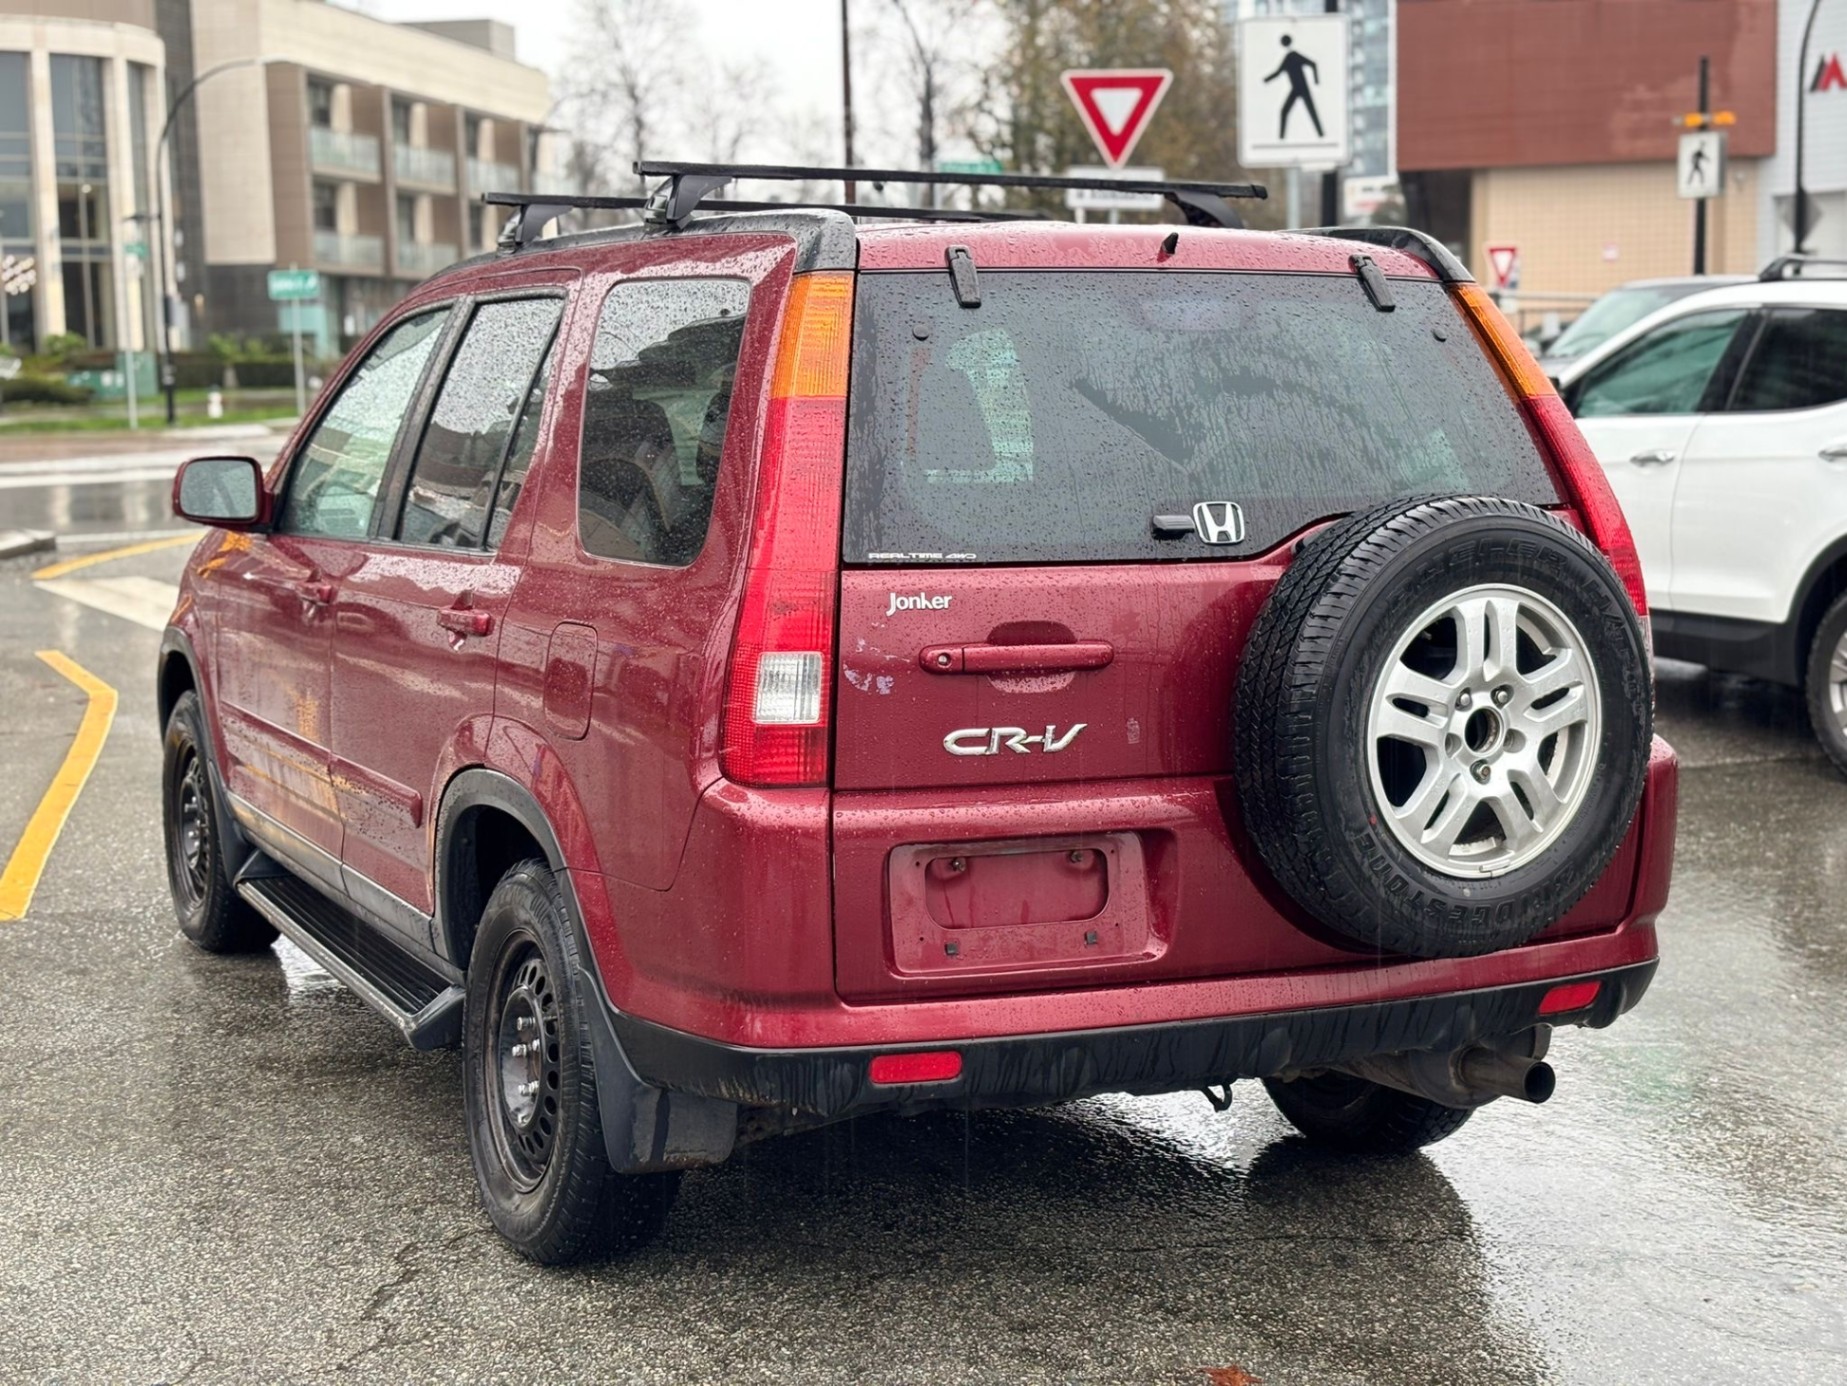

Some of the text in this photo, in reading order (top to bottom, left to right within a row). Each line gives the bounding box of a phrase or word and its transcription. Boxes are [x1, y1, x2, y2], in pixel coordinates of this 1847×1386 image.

[945, 552, 977, 560] 4WD
[885, 592, 953, 617] Jonker
[943, 723, 1088, 756] CR-V
